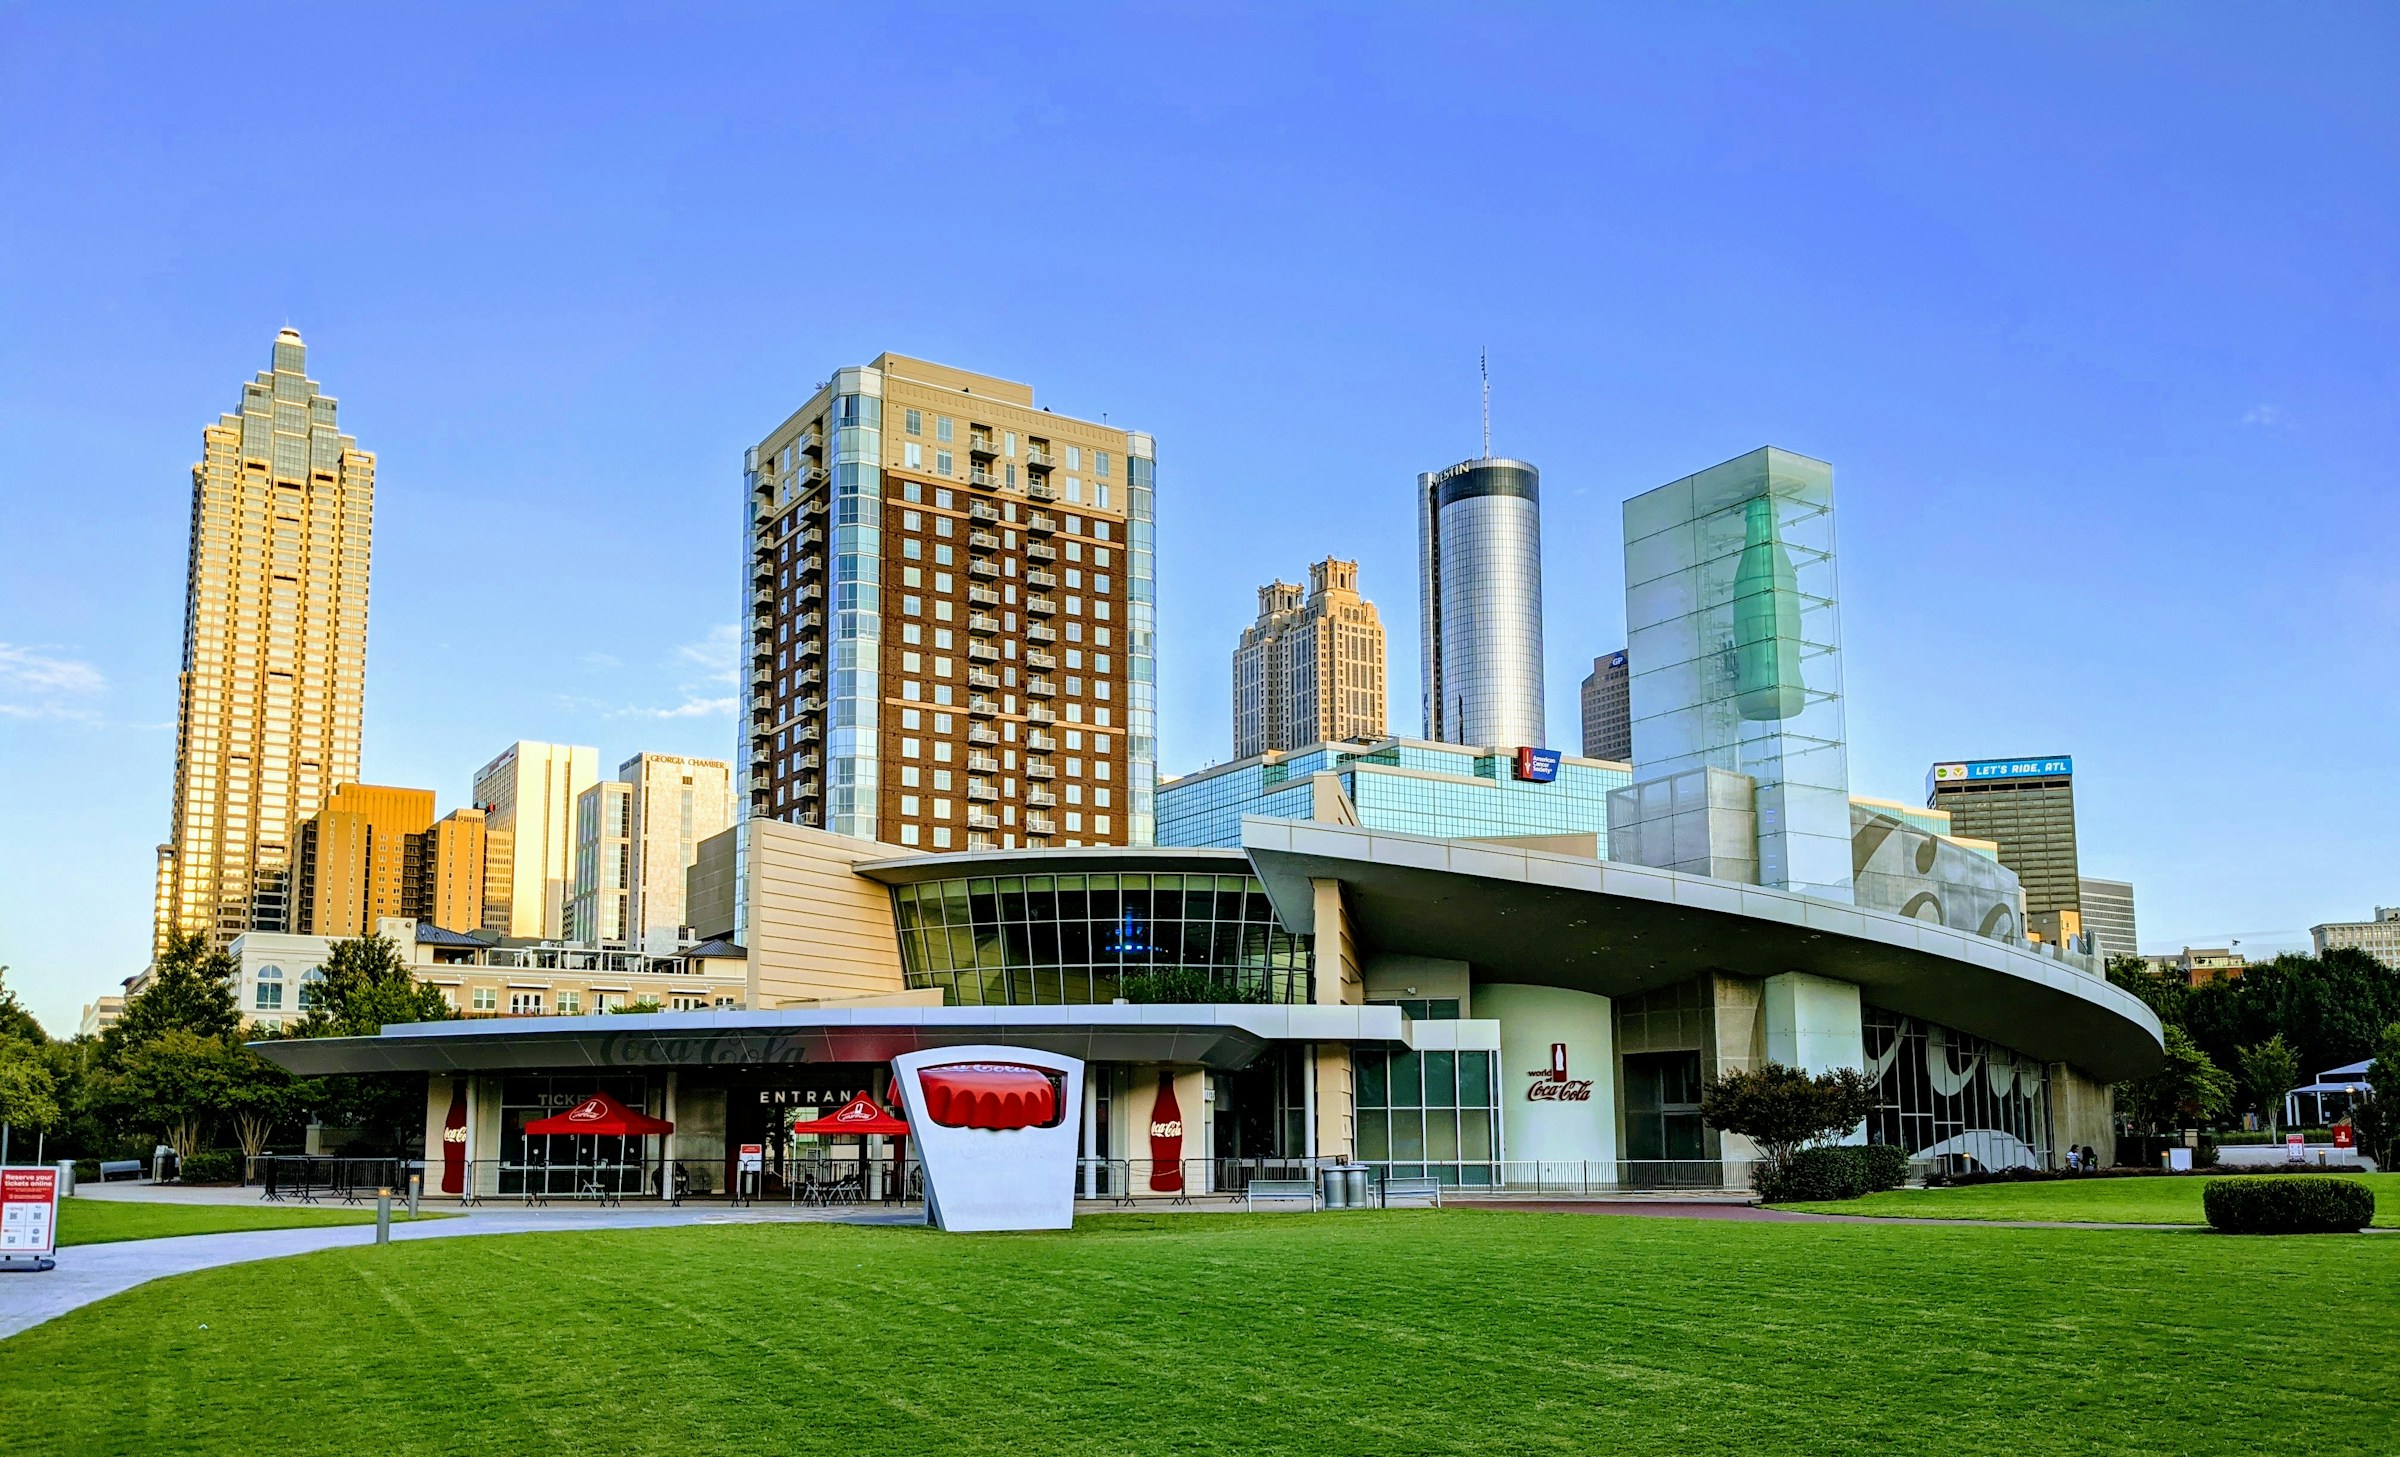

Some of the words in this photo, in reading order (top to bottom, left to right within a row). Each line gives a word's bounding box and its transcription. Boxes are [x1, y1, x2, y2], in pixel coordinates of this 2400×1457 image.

[1612, 656, 1624, 666] GP
[650, 755, 686, 765] GEORGIA
[688, 758, 725, 769] CHAMBER
[1533, 754, 1556, 763] American
[1976, 764, 2008, 776] LET'S
[2012, 763, 2041, 774] RIDE,
[2045, 761, 2067, 772] ATL
[1527, 1069, 1552, 1077] world
[760, 1090, 868, 1103] ENTRAN
[1527, 1080, 1594, 1101] Coca-Cola
[538, 1093, 594, 1107] TICKE
[35, 1175, 53, 1183] your
